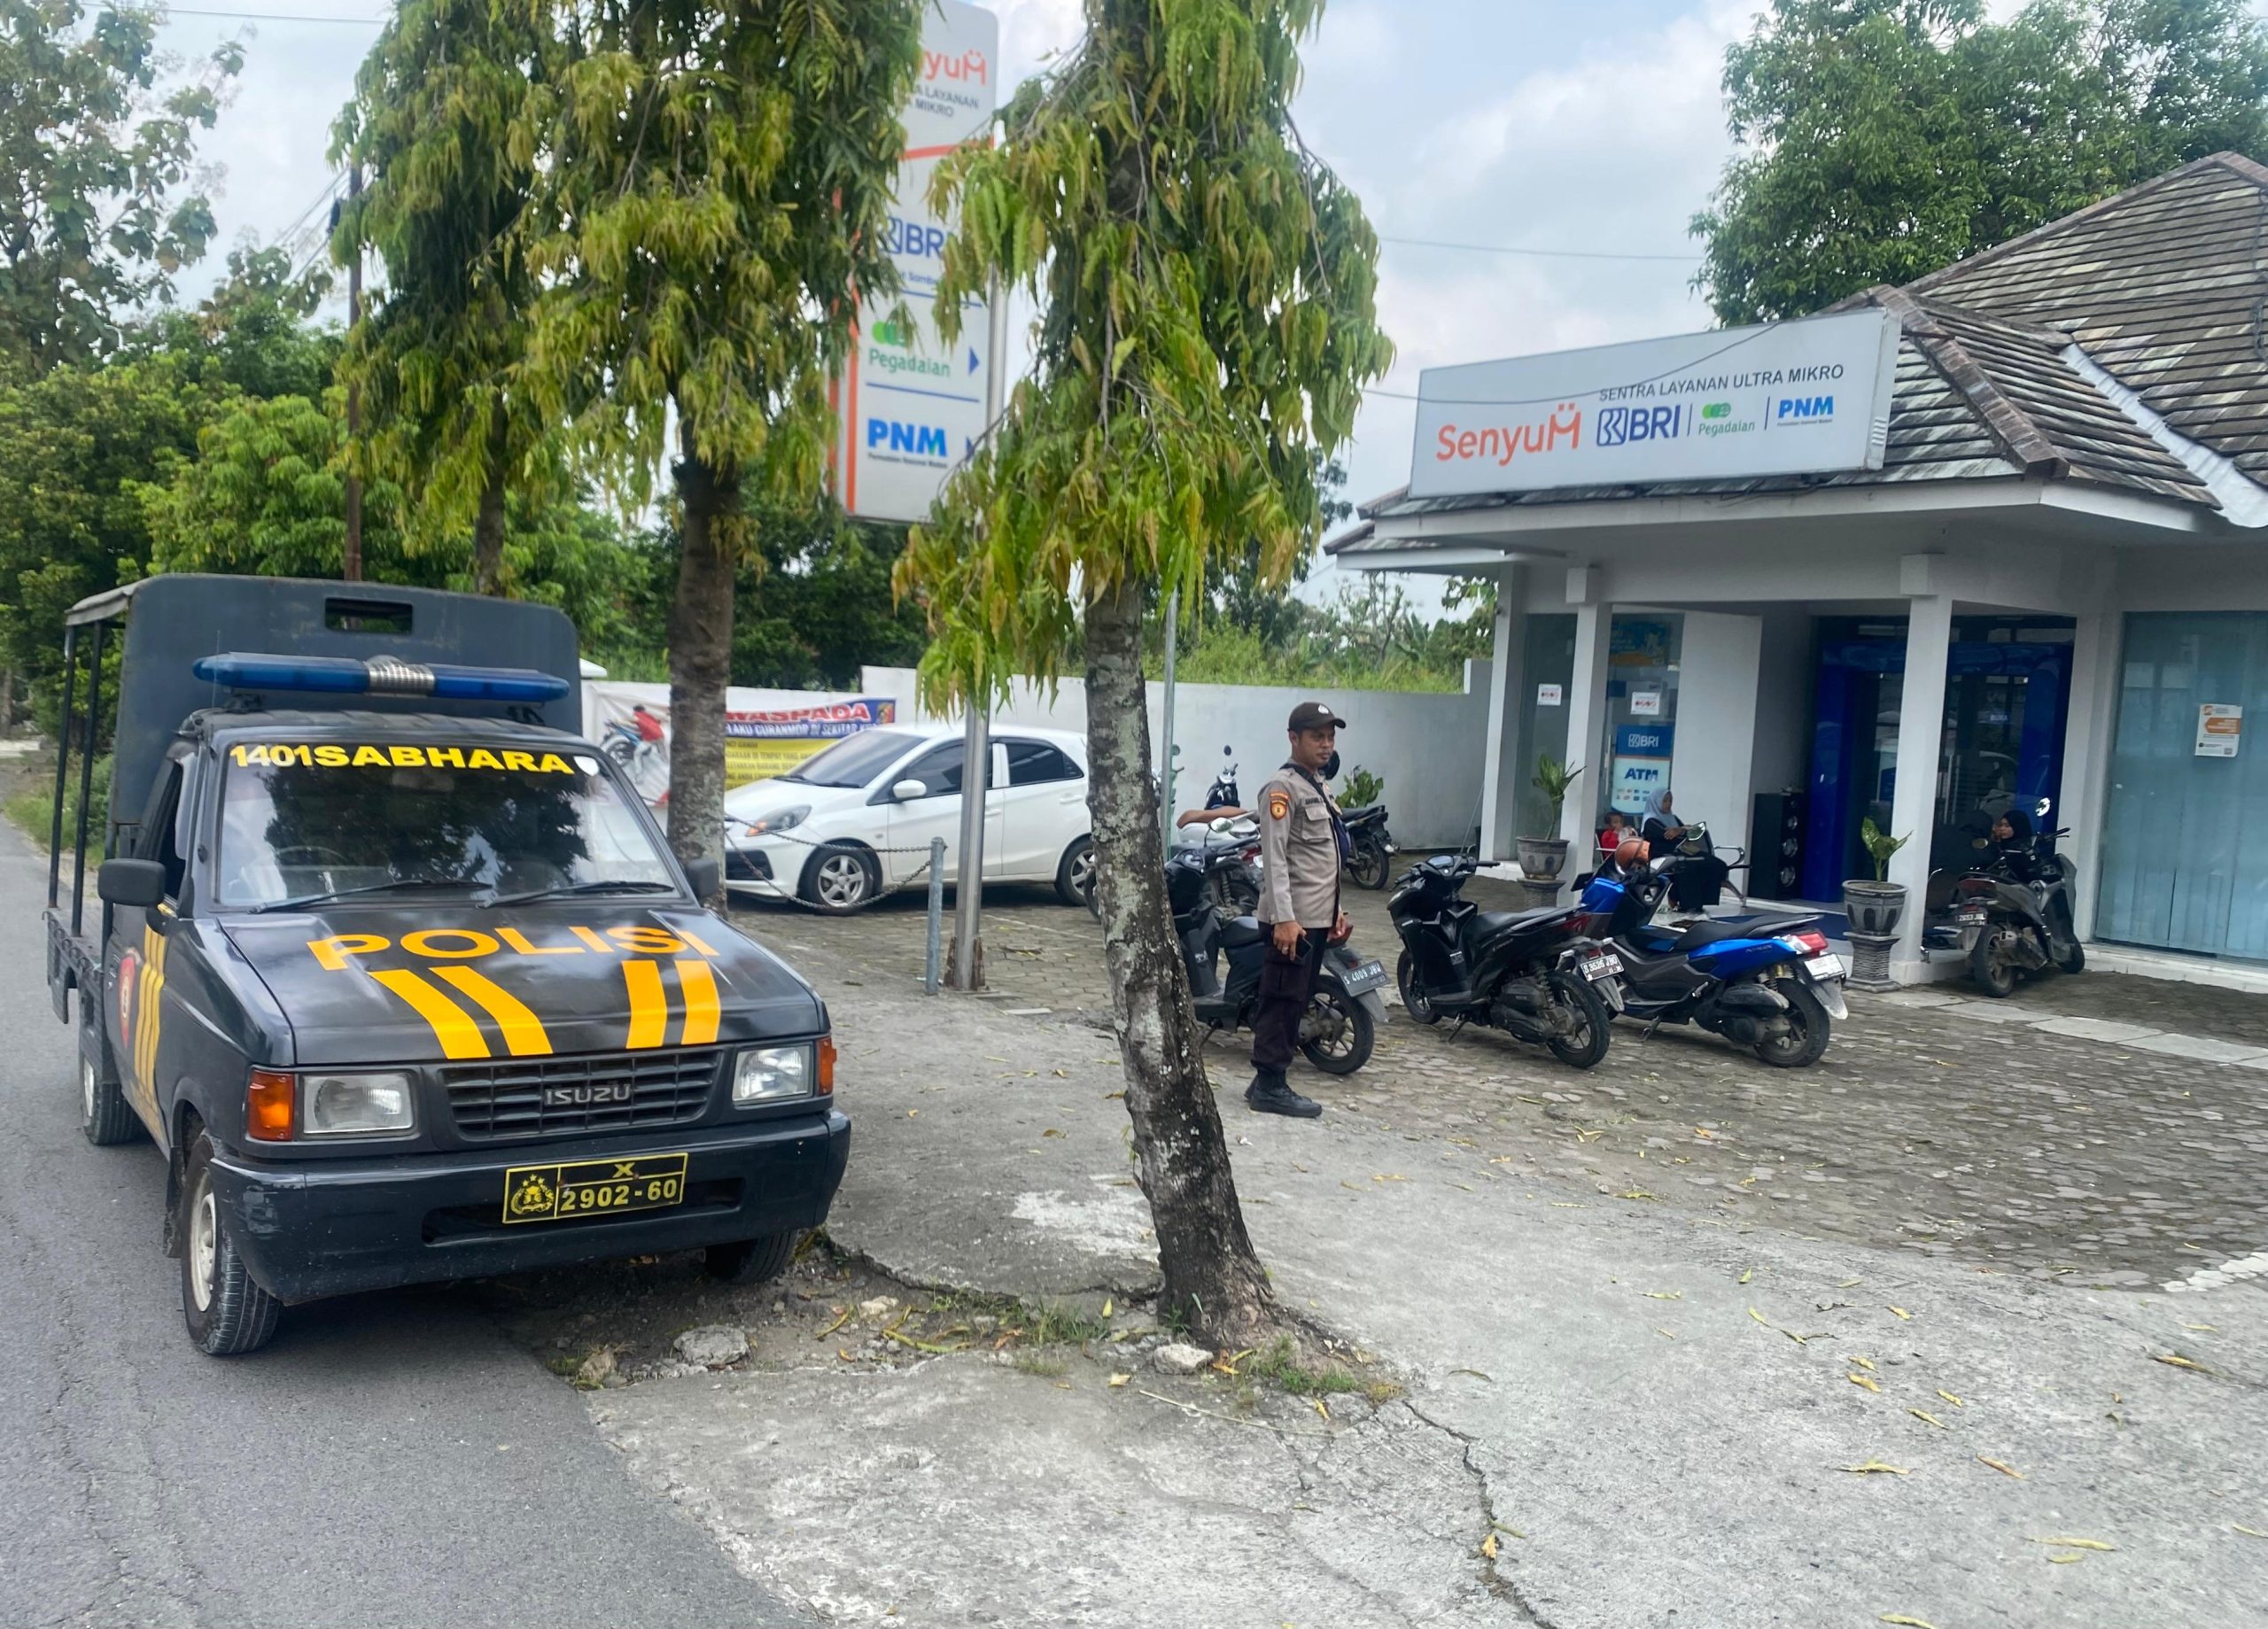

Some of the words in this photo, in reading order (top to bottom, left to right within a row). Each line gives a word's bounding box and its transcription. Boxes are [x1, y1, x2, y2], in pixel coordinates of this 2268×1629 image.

[915, 97, 954, 117] MIKRO
[924, 87, 979, 109] LAYANAN
[906, 223, 944, 259] BR
[868, 348, 951, 377] Pegadaian
[1599, 382, 1655, 401] SENTRA
[1659, 375, 1728, 394] LAYANAN
[1733, 369, 1783, 388] ULTRA
[1788, 364, 1844, 383] MIKRO
[1777, 395, 1833, 418] PNM
[1628, 404, 1681, 442] BRI
[1698, 419, 1755, 438] Pegadaian
[866, 417, 947, 457] PNM
[725, 702, 871, 723] WASPADA
[1640, 735, 1659, 748] BRI
[1624, 768, 1658, 780] ATM
[307, 926, 720, 970] POLISI
[544, 1083, 632, 1105] ISUZU
[612, 1162, 636, 1178] X
[560, 1179, 678, 1212] 2902-60
